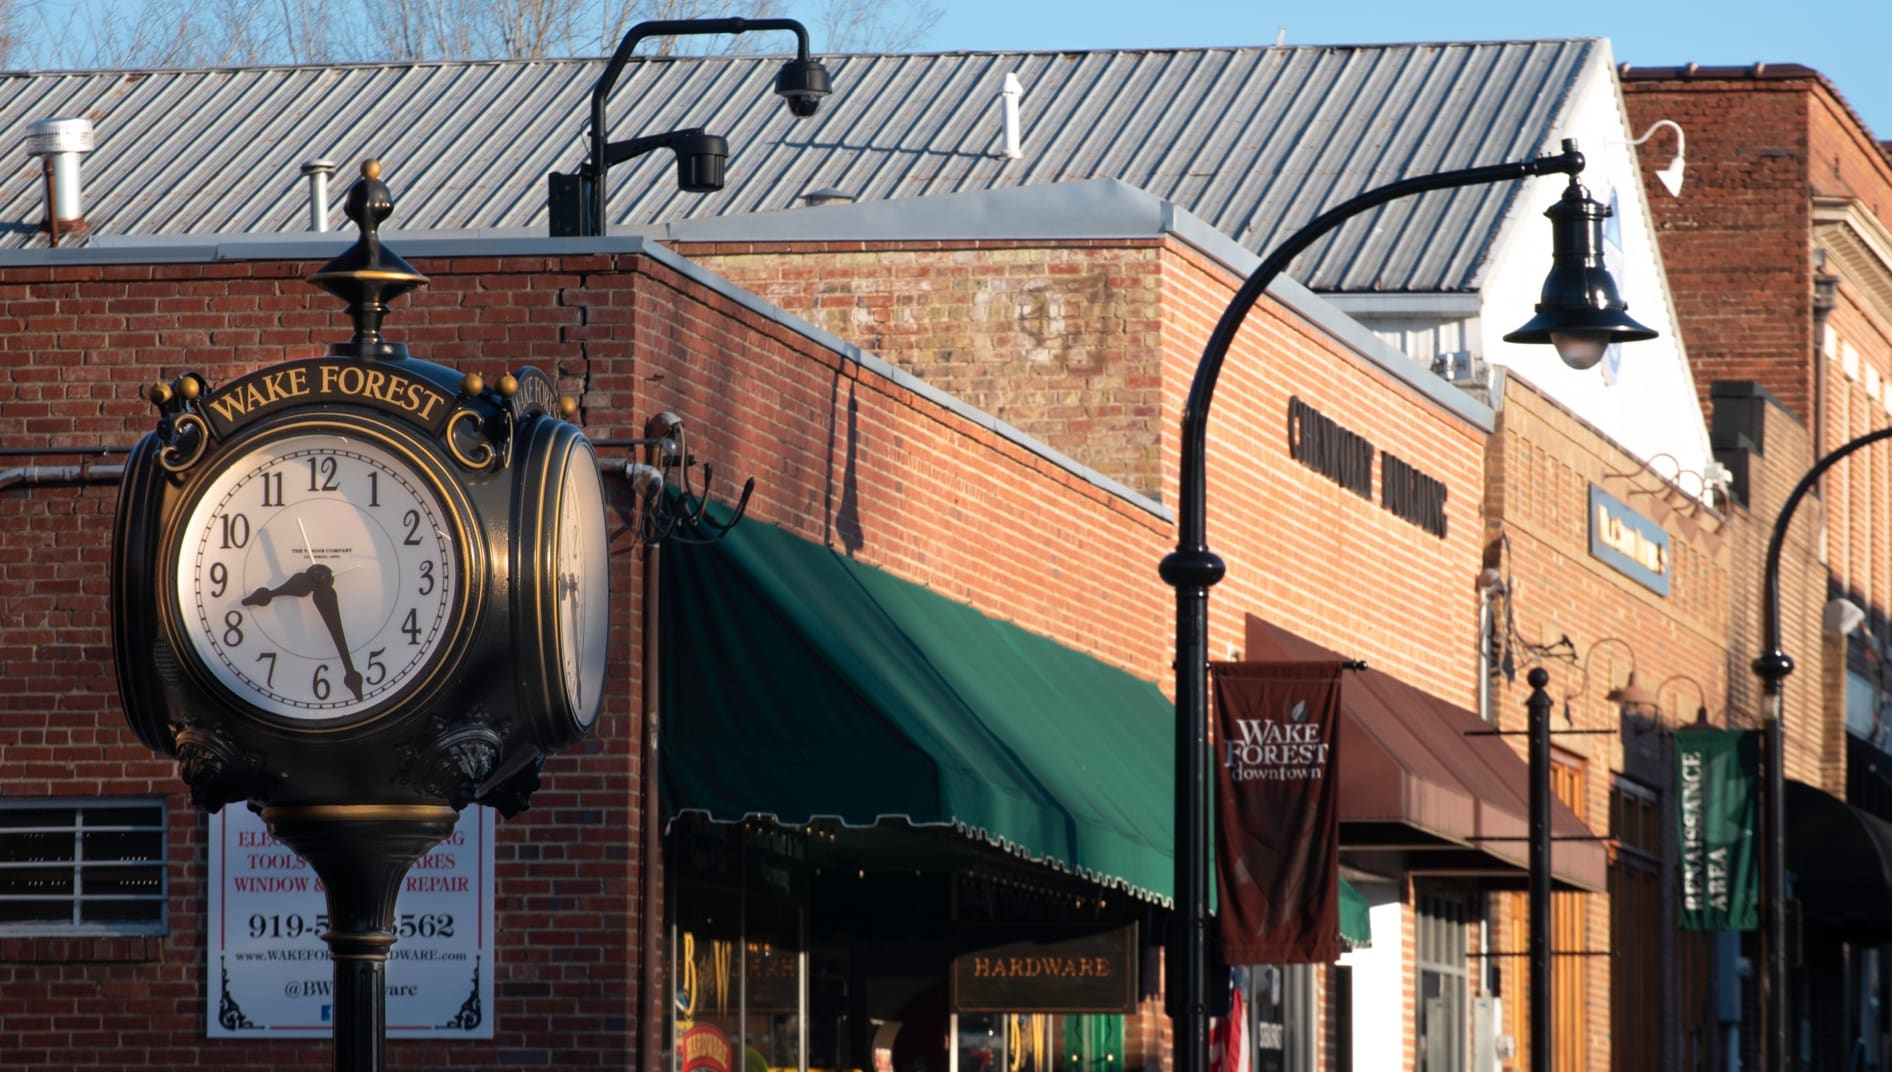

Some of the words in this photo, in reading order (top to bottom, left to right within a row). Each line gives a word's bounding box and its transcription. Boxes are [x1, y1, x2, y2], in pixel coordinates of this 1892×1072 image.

[209, 367, 310, 423] WAKE
[319, 365, 446, 421] FOREST
[534, 376, 562, 420] FORES
[261, 471, 286, 507] 11
[306, 456, 340, 492] 12
[367, 471, 382, 507] 1
[219, 513, 250, 549] 10
[403, 509, 424, 546] 2
[210, 562, 228, 598] 9
[419, 560, 435, 596] 3
[223, 611, 244, 647] 8
[401, 608, 422, 645] 4
[256, 652, 277, 689] 7
[312, 664, 330, 701] 6
[366, 647, 387, 686] 5
[1236, 718, 1320, 748] WAKE
[1223, 739, 1328, 767] FOREST
[1232, 761, 1321, 781] downtown
[247, 853, 306, 870] TOOLS
[233, 876, 310, 893] WINDOW
[405, 876, 469, 892] REPAIR
[1708, 848, 1728, 912] AREA
[973, 956, 1112, 977] HARDWARE
